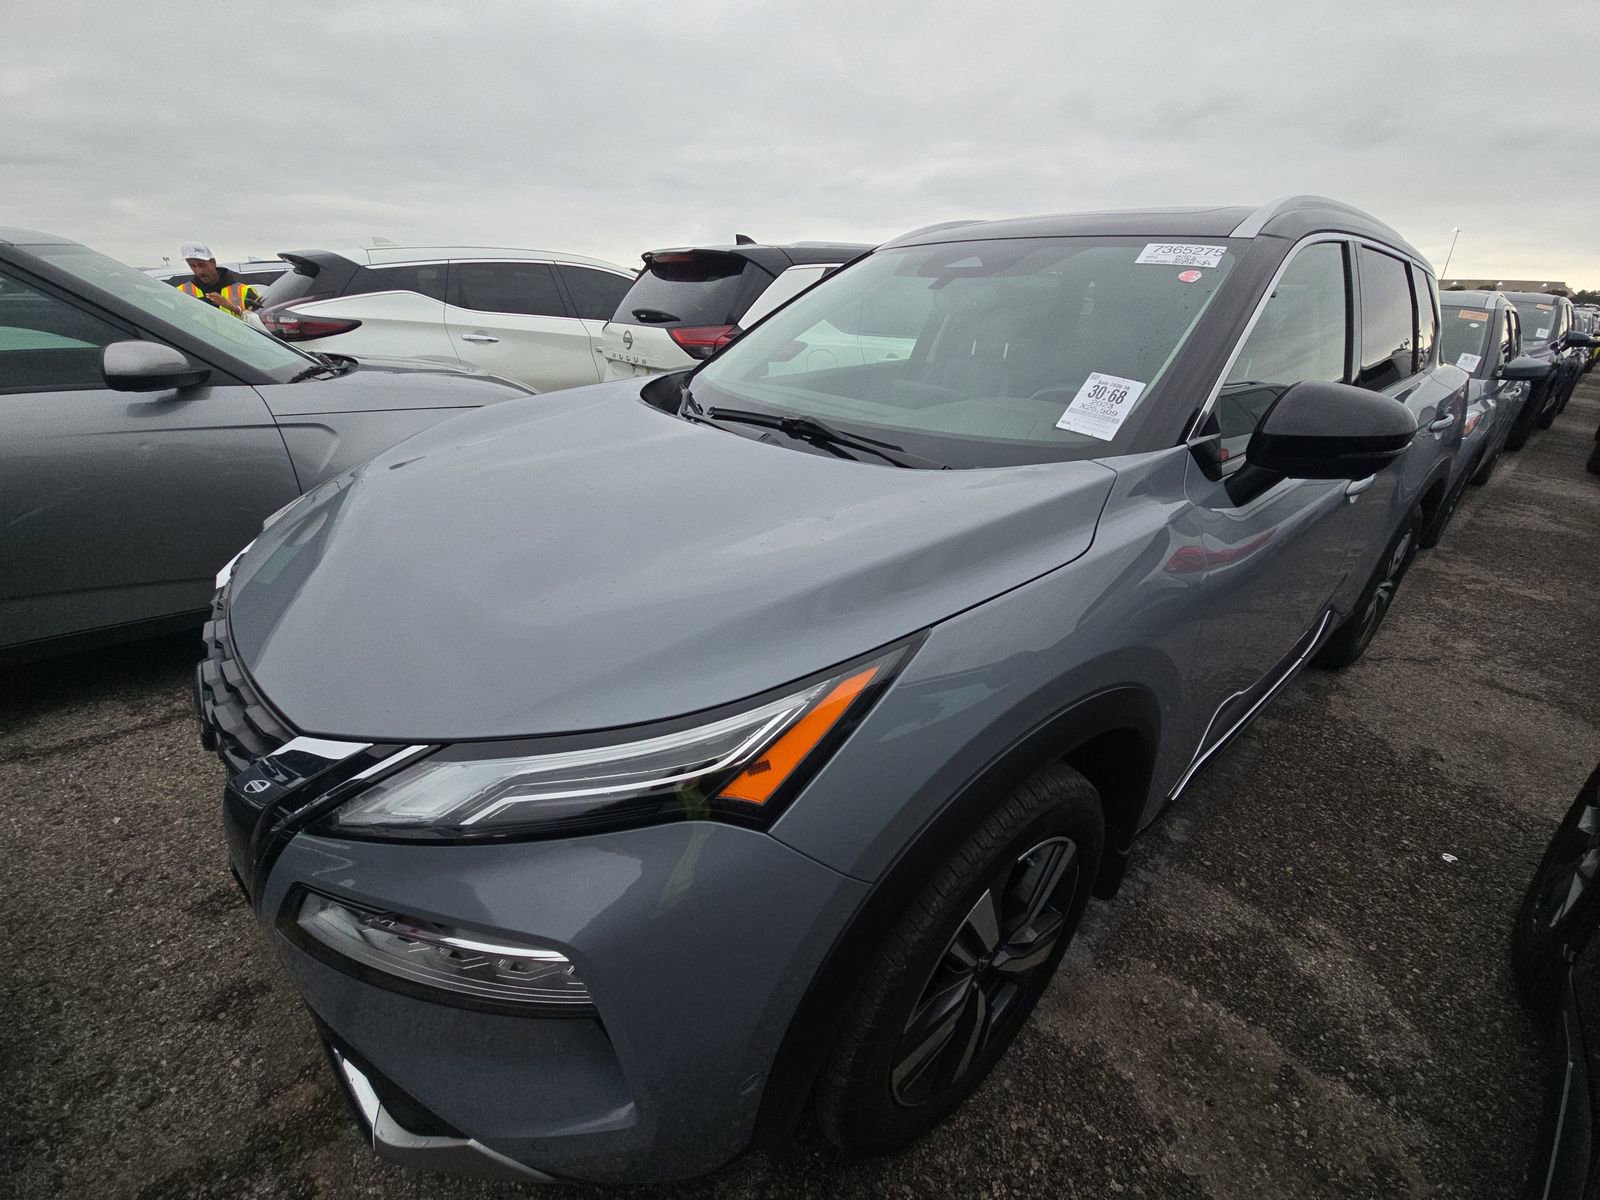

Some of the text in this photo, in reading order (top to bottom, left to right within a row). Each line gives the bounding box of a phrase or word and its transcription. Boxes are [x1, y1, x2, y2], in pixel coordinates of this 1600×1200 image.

[1153, 245, 1225, 257] 7365275
[1087, 384, 1128, 405] 30:68
[1090, 400, 1115, 410] 2023
